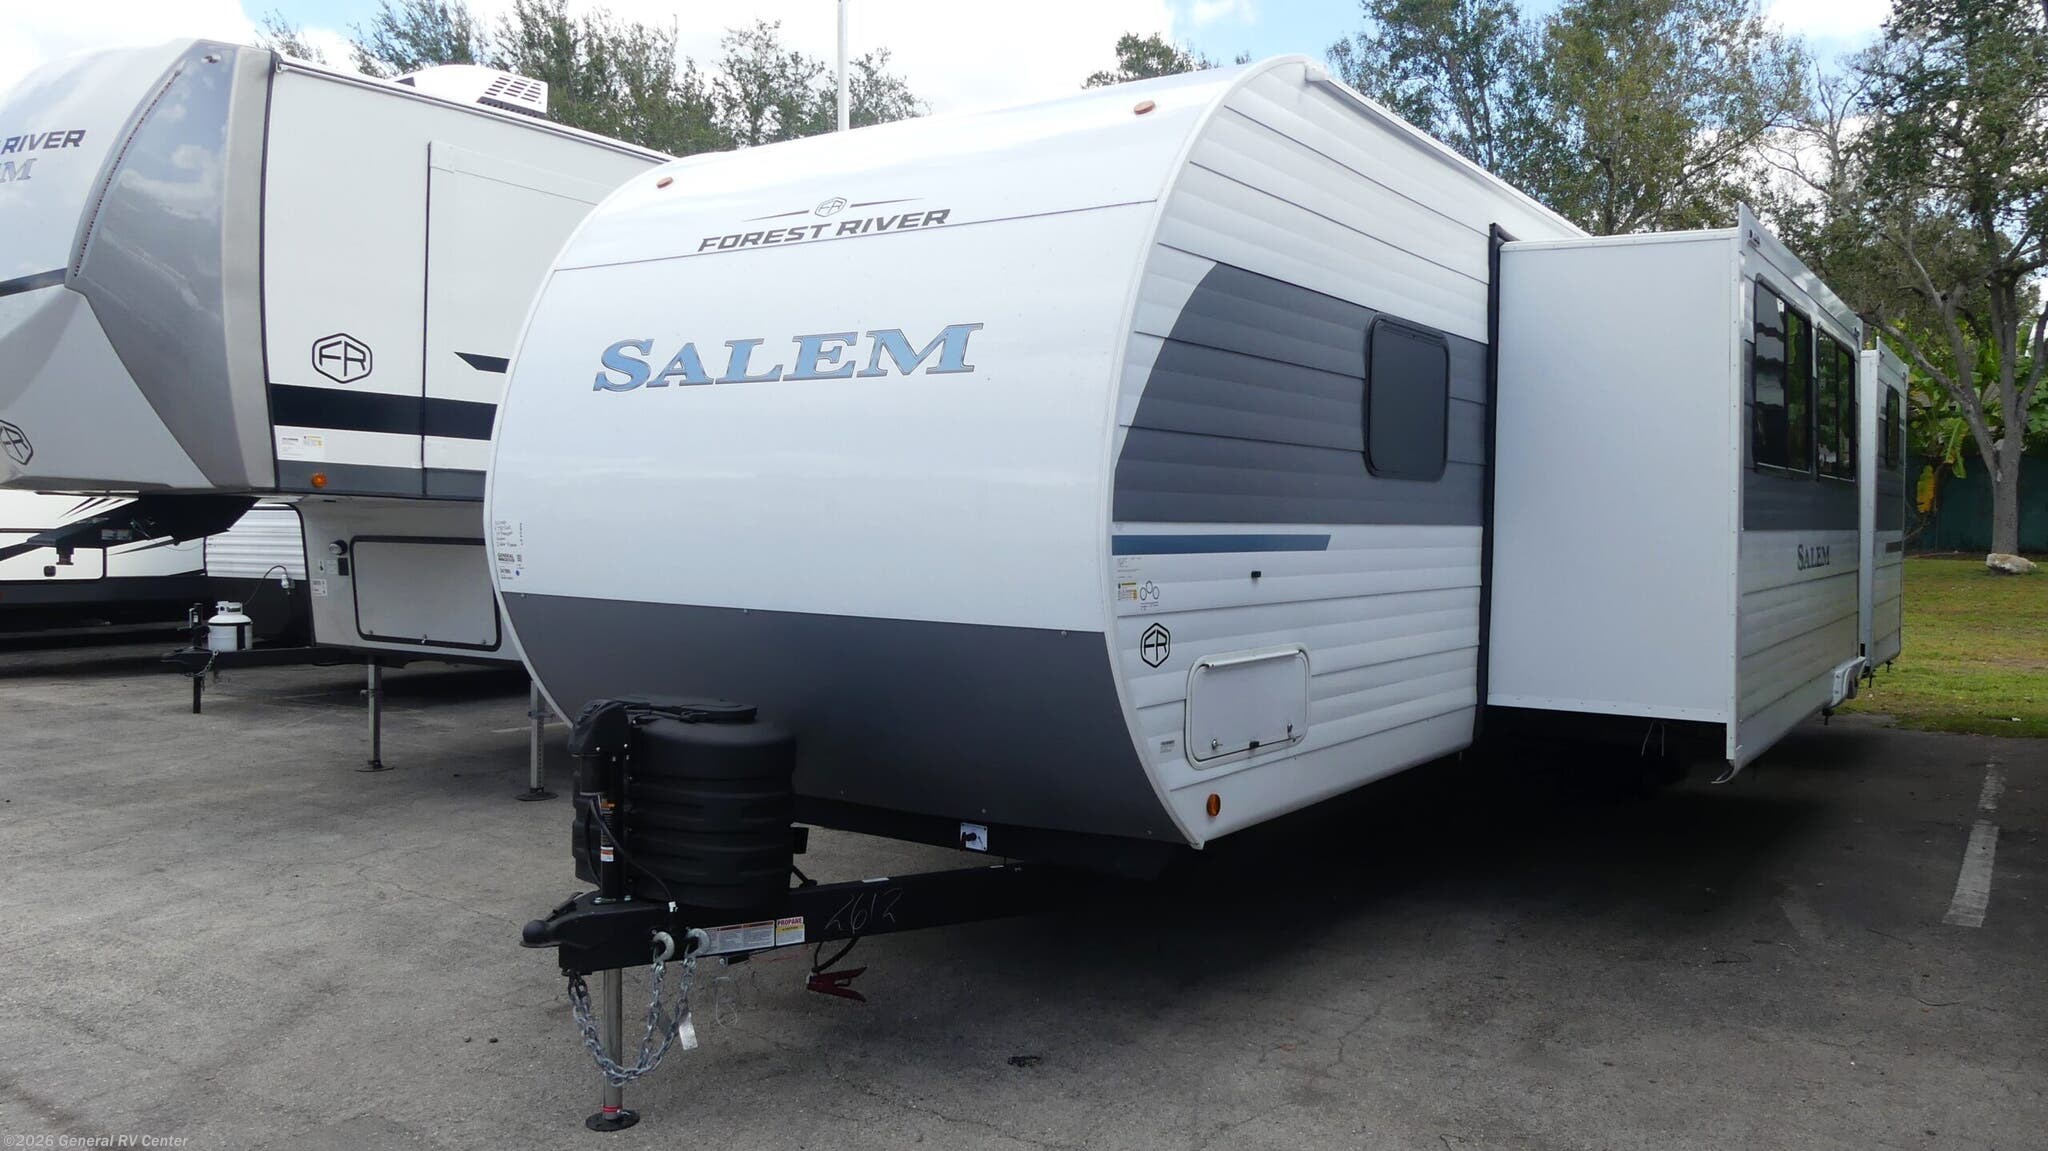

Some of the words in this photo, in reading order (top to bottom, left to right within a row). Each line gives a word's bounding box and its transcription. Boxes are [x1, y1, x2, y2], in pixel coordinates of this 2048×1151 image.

[0, 129, 86, 154] RIVER
[698, 223, 832, 252] FOREST
[836, 208, 951, 236] RIVER
[592, 322, 984, 392] SALEM
[1796, 543, 1831, 571] SALEM
[823, 887, 904, 935] 2612
